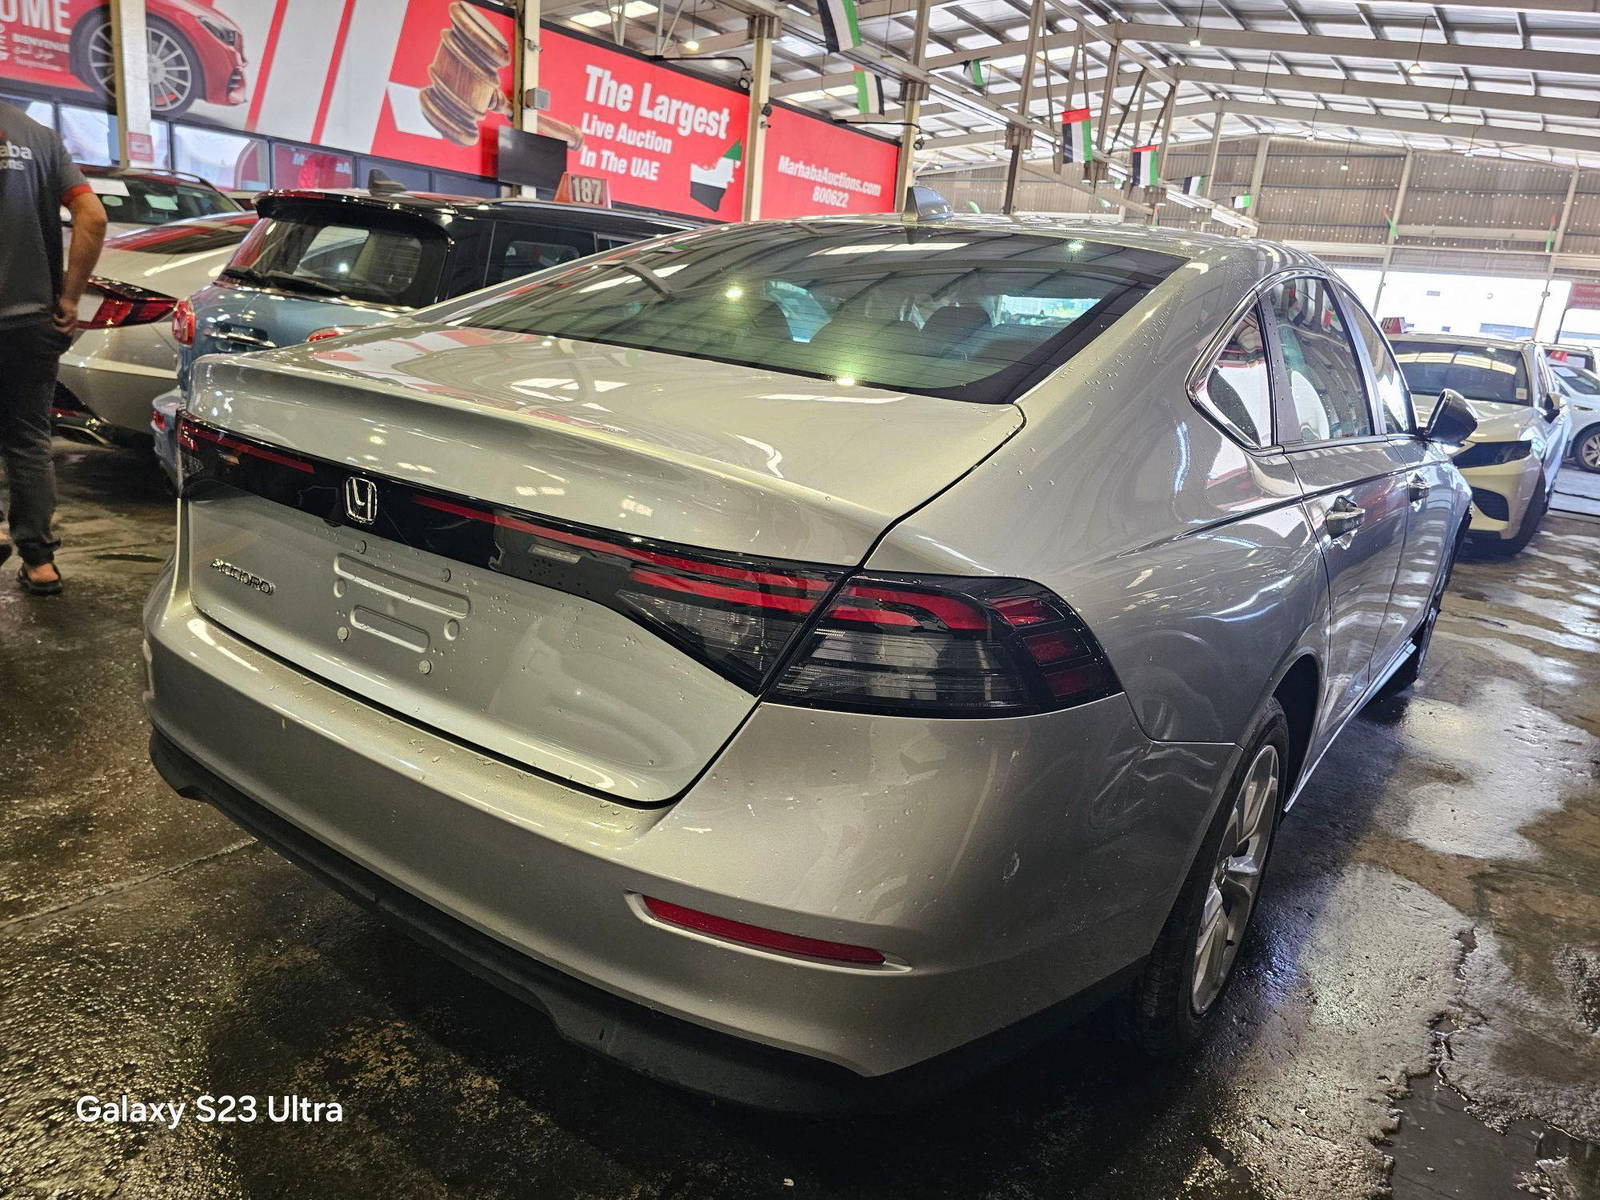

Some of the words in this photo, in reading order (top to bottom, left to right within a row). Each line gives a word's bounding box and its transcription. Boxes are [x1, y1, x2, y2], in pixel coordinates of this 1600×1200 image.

[585, 64, 634, 113] The
[638, 82, 730, 139] Largest
[581, 113, 614, 140] Live
[616, 123, 673, 154] Auction
[580, 145, 596, 168] In
[600, 149, 627, 174] The
[630, 156, 661, 181] UAE
[777, 155, 882, 197] MarhabaAuctions.com
[572, 177, 602, 204] 187
[812, 186, 849, 208] 800622
[209, 558, 276, 595] ACCORD
